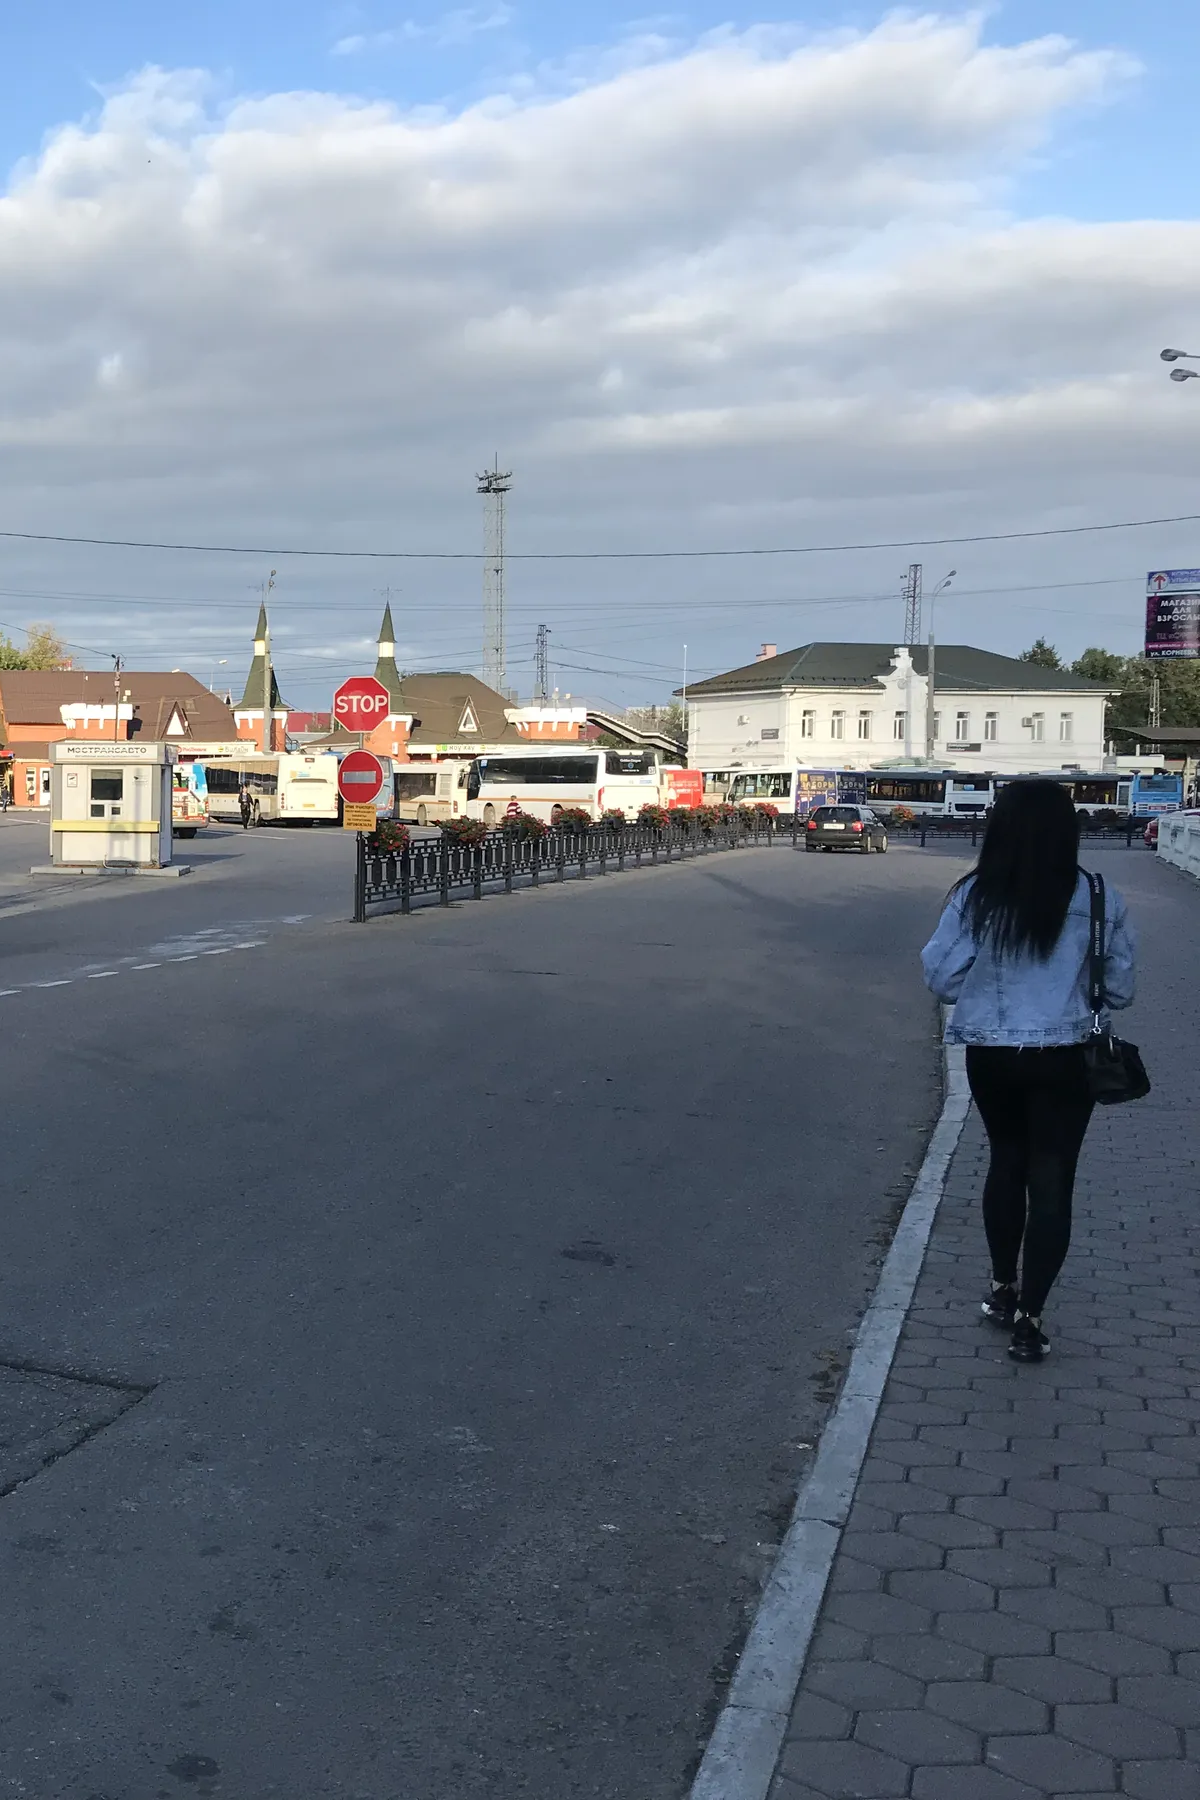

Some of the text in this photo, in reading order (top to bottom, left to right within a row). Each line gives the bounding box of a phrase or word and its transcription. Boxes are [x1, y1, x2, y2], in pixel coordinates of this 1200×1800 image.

[1160, 599, 1200, 607] МАГАЗИ
[1172, 606, 1191, 614] ДЛЯ
[1157, 614, 1200, 622] ВЗРОСЛЫ
[336, 695, 387, 713] STOP
